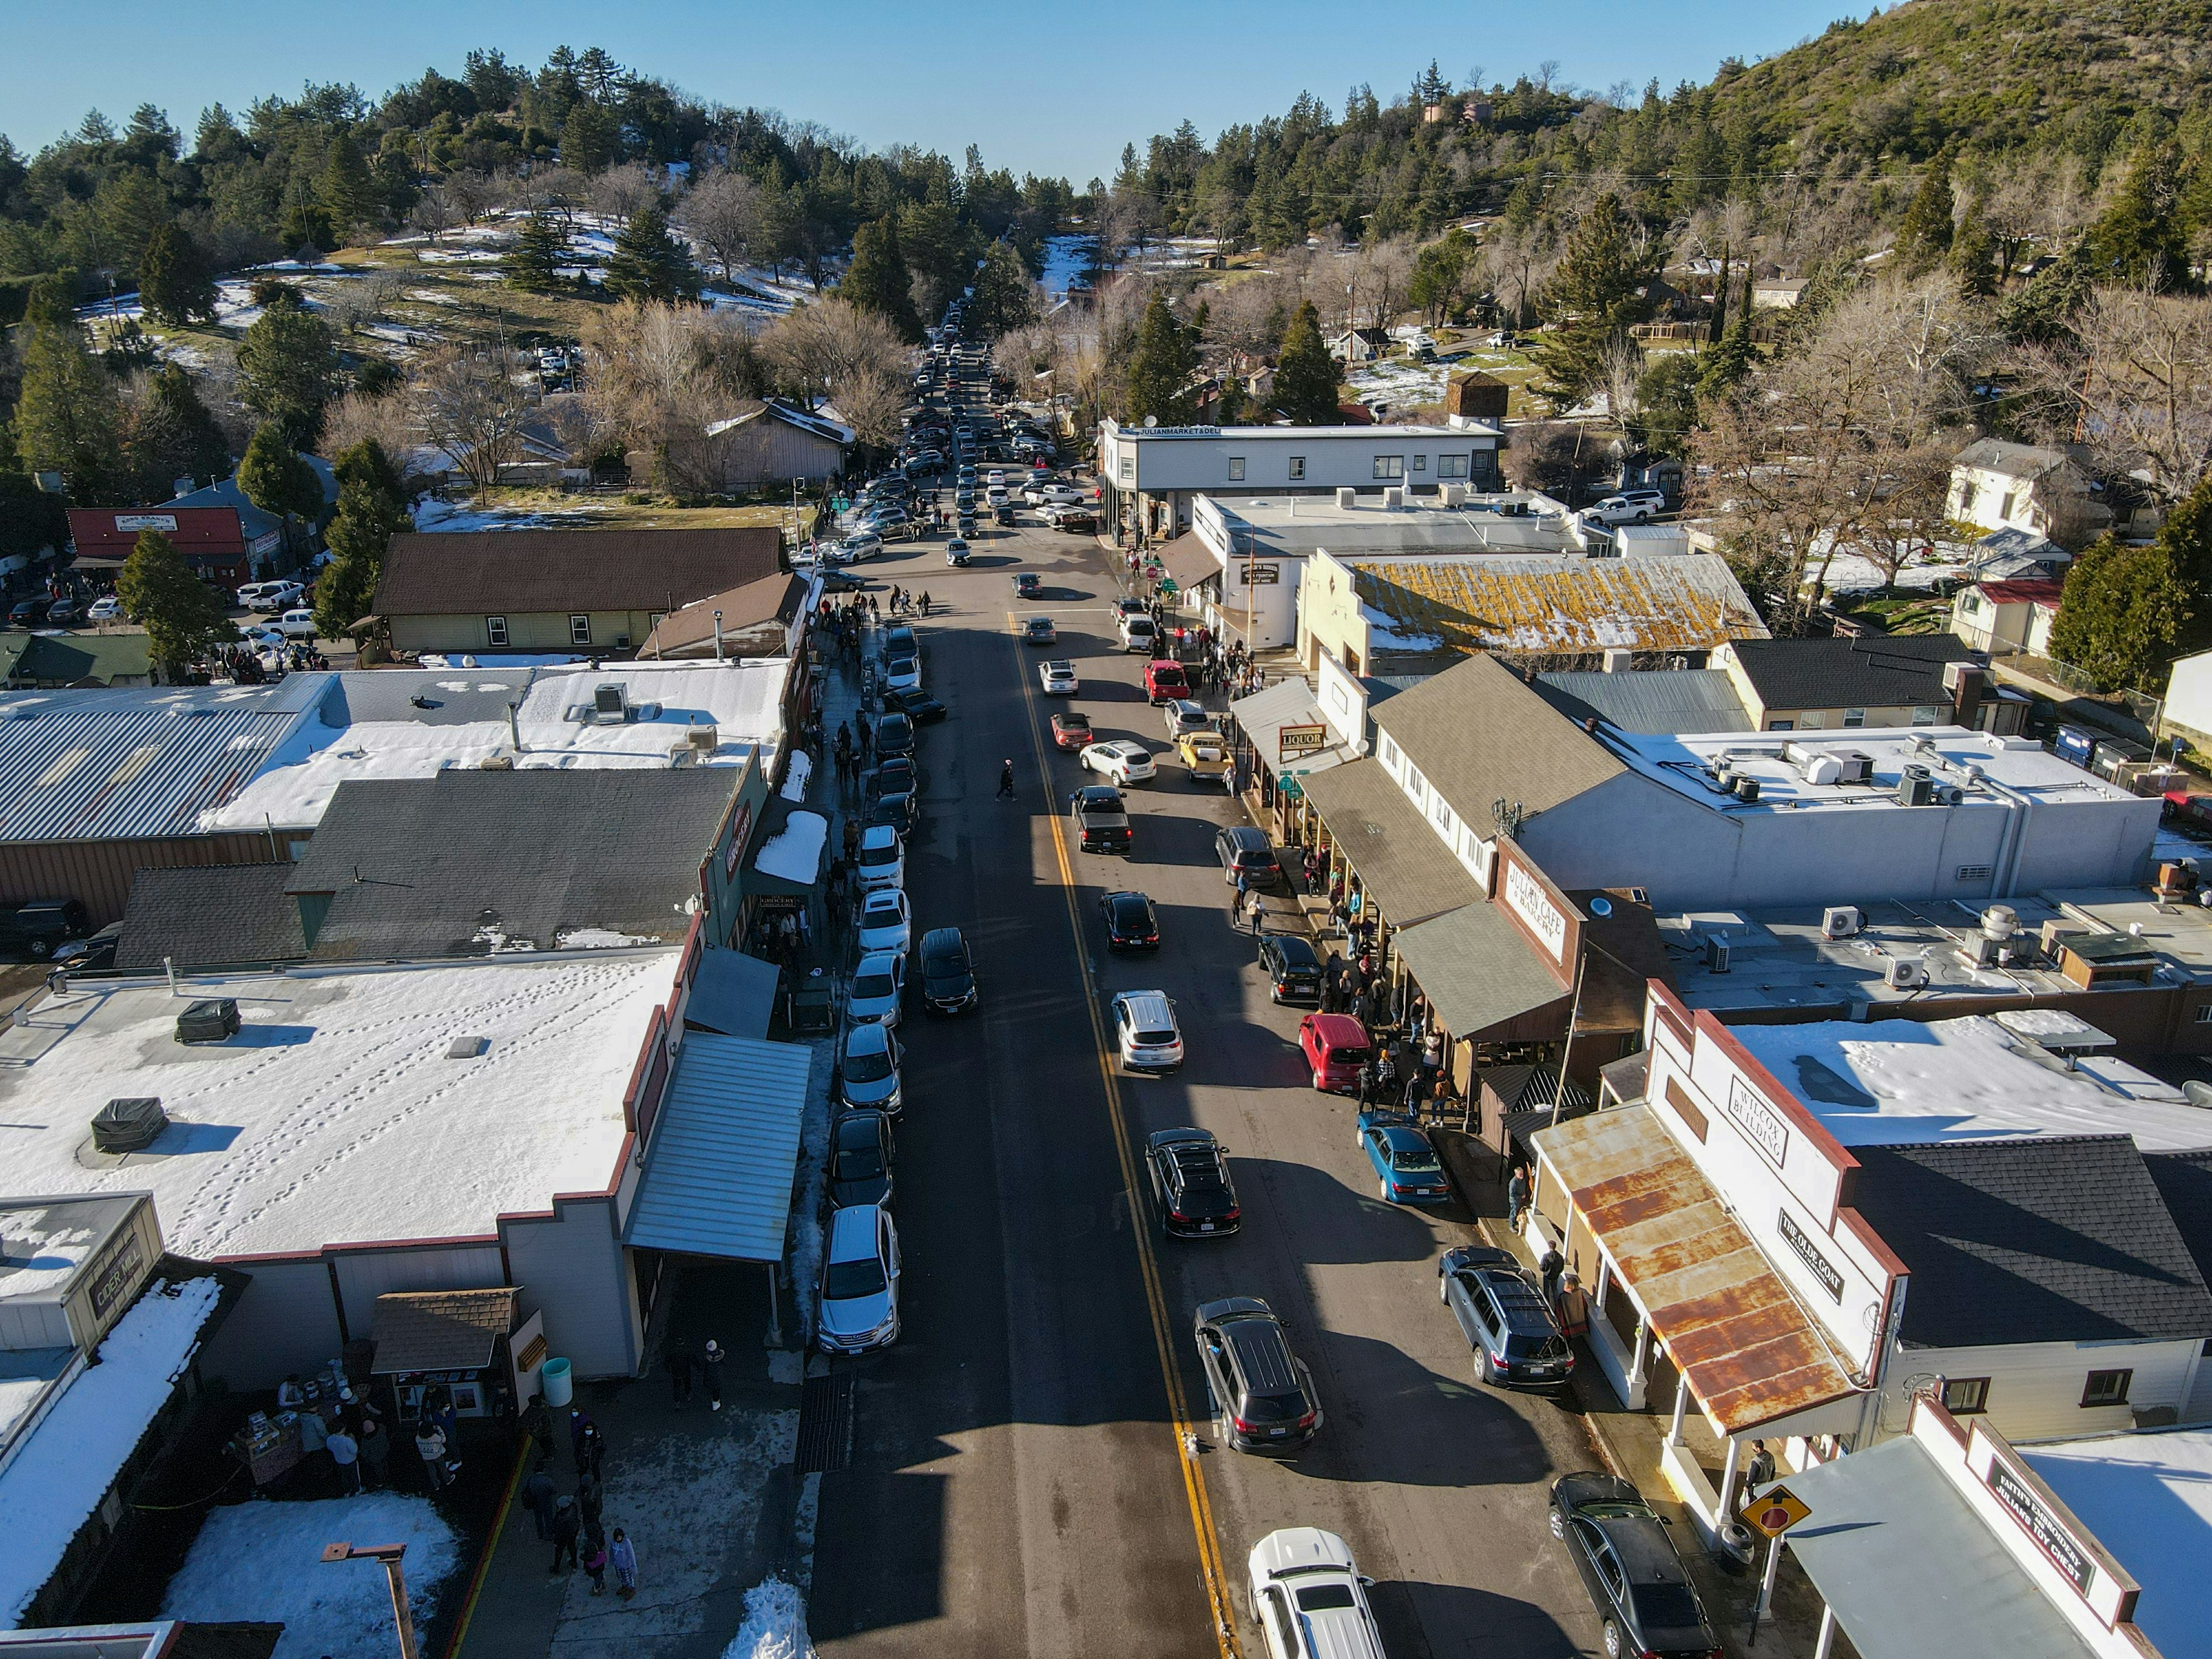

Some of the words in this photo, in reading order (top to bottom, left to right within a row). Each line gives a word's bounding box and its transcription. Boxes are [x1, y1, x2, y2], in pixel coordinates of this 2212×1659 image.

[1283, 734, 1321, 745] LIQUOR
[728, 808, 750, 872] GROCERY
[1510, 868, 1539, 910] JULIAN
[1540, 902, 1561, 935] CAFE
[1520, 895, 1554, 938] BAKERY
[1733, 1099, 1781, 1156] BUILDING
[1741, 1090, 1779, 1140] WILCOX
[97, 1270, 121, 1306] CIDER
[122, 1249, 141, 1275] MILL
[1782, 1215, 1798, 1239] THE
[1798, 1234, 1819, 1264] OLDE
[1819, 1259, 1840, 1290] GOAT
[2000, 1475, 2031, 1507] FAITH'S
[2031, 1502, 2082, 1567] EMBROIDERY
[2035, 1516, 2045, 1530] AND
[2033, 1521, 2051, 1546] TOY
[2050, 1543, 2081, 1581] CHEST
